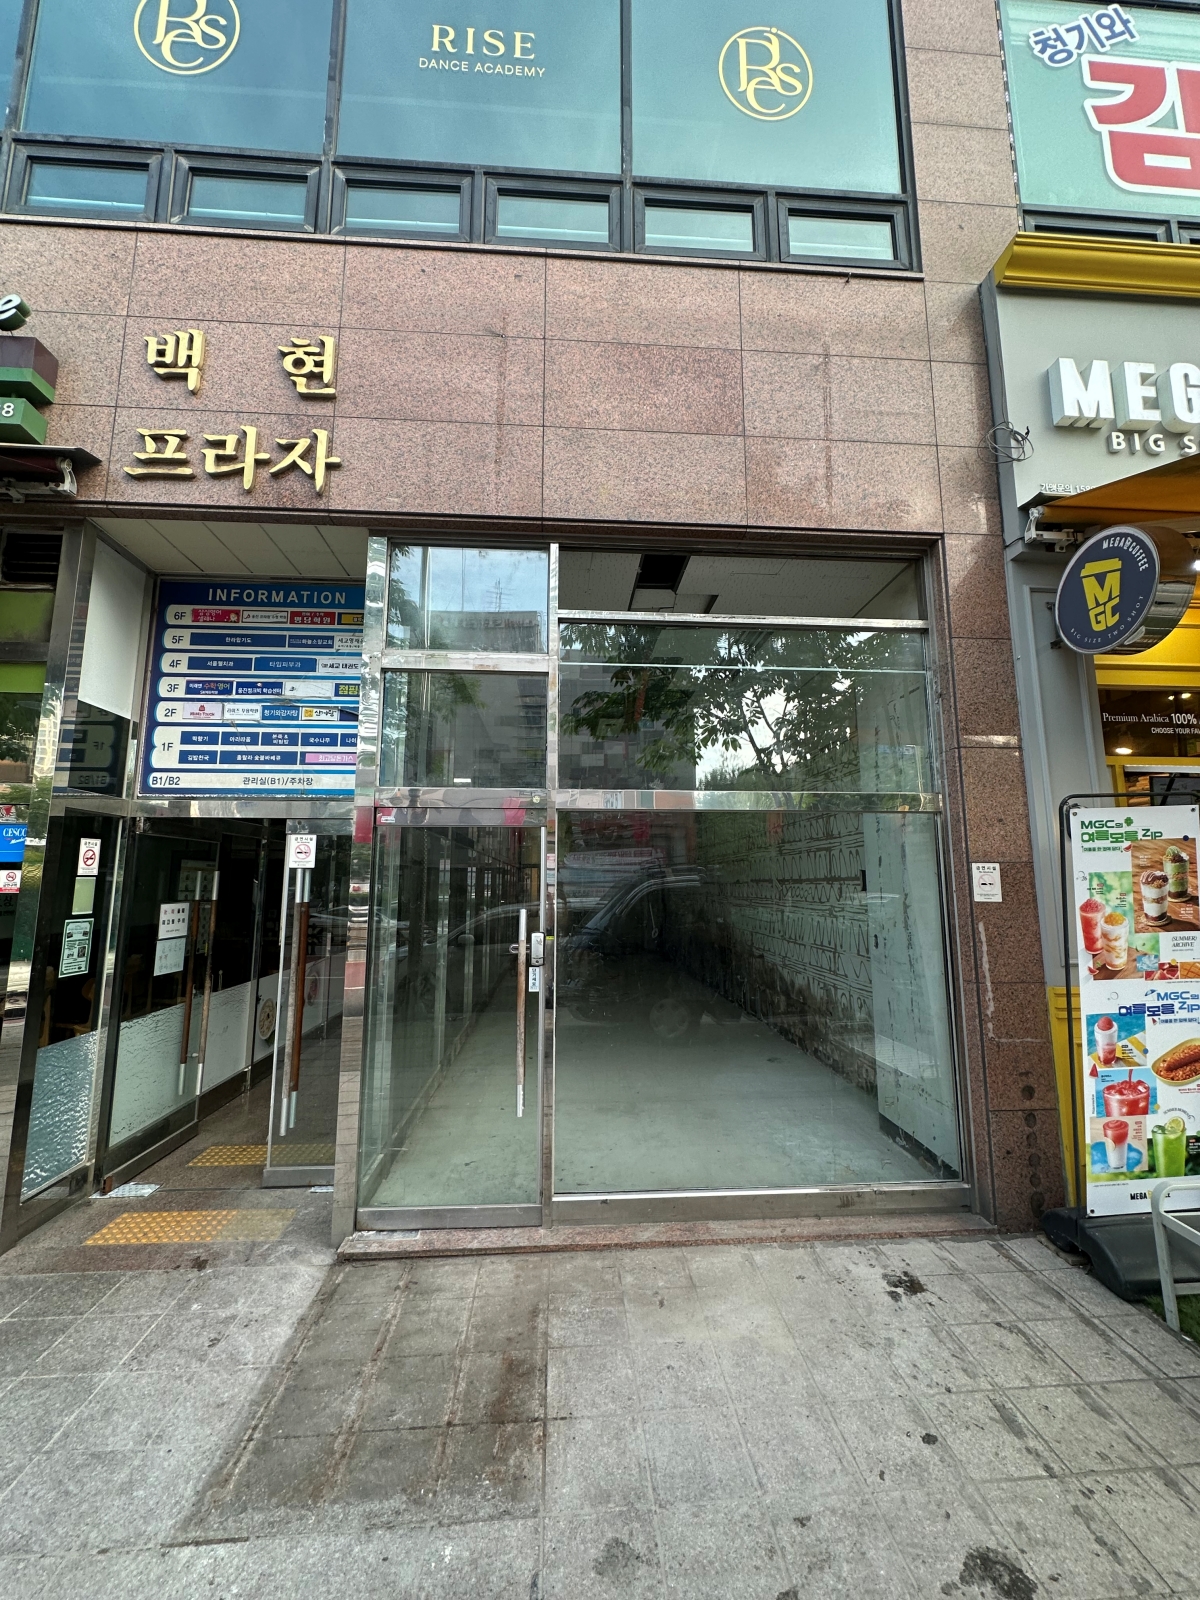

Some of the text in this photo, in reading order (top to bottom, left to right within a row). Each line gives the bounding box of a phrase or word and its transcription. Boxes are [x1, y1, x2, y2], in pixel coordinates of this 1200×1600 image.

[431, 24, 536, 59] RISE
[1030, 5, 1138, 65] 청기와
[419, 57, 545, 78] DANCE ACADEMY
[1085, 58, 1200, 190] 감
[1110, 431, 1165, 454] BIG
[123, 424, 341, 495] 프라자
[1103, 537, 1149, 571] MEGA COFFEE
[209, 588, 346, 604] INFORMATION
[174, 611, 187, 621] 6F
[1108, 625, 1124, 638] TWO
[1127, 596, 1143, 621] SHOT
[172, 636, 184, 644] 5F
[169, 660, 182, 668] 4F
[167, 684, 179, 692] 3F
[164, 709, 177, 717] 2F
[1102, 713, 1197, 725] Premium Arabica 100%
[162, 743, 174, 751] 1F
[152, 776, 181, 786] B1/B2
[243, 777, 314, 786] 관리실(B1)/주차장
